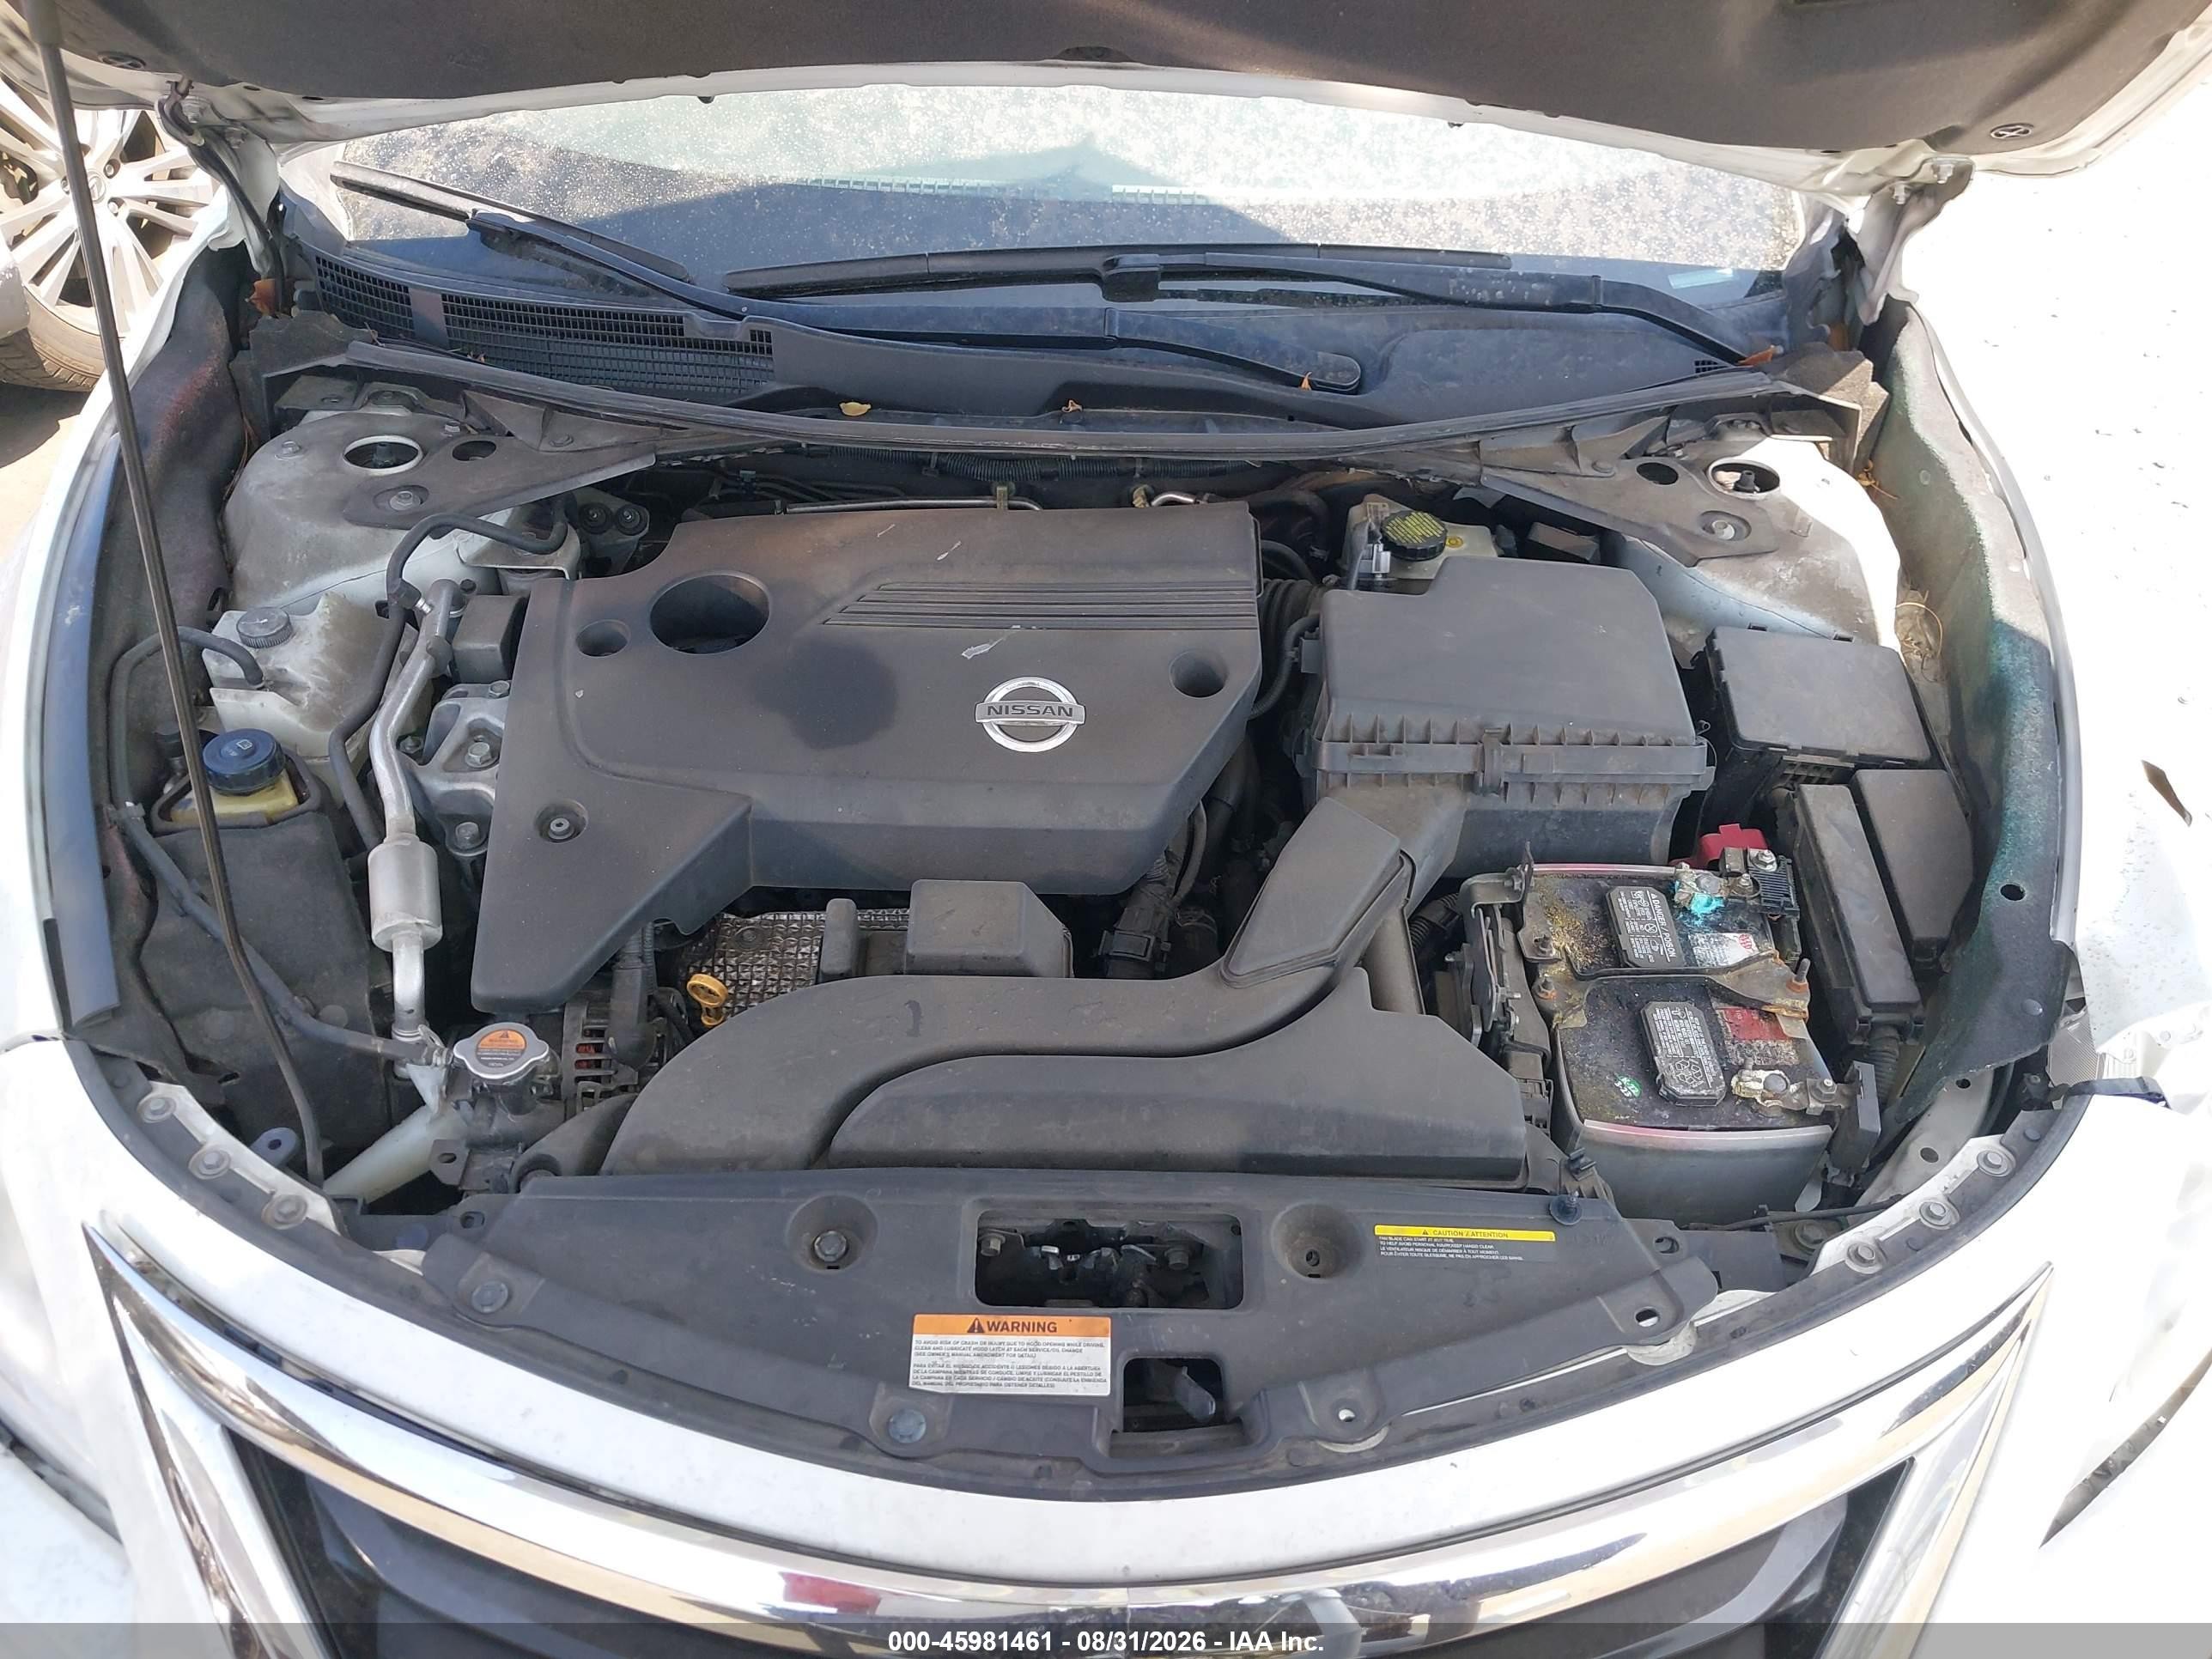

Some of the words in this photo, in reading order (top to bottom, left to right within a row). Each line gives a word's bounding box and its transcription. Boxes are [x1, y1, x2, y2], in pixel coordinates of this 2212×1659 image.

[987, 705, 1073, 717] NISSAN
[1652, 900, 1667, 927] DANGER
[1662, 933, 1676, 957] POISON
[988, 1321, 1057, 1333] WARNING
